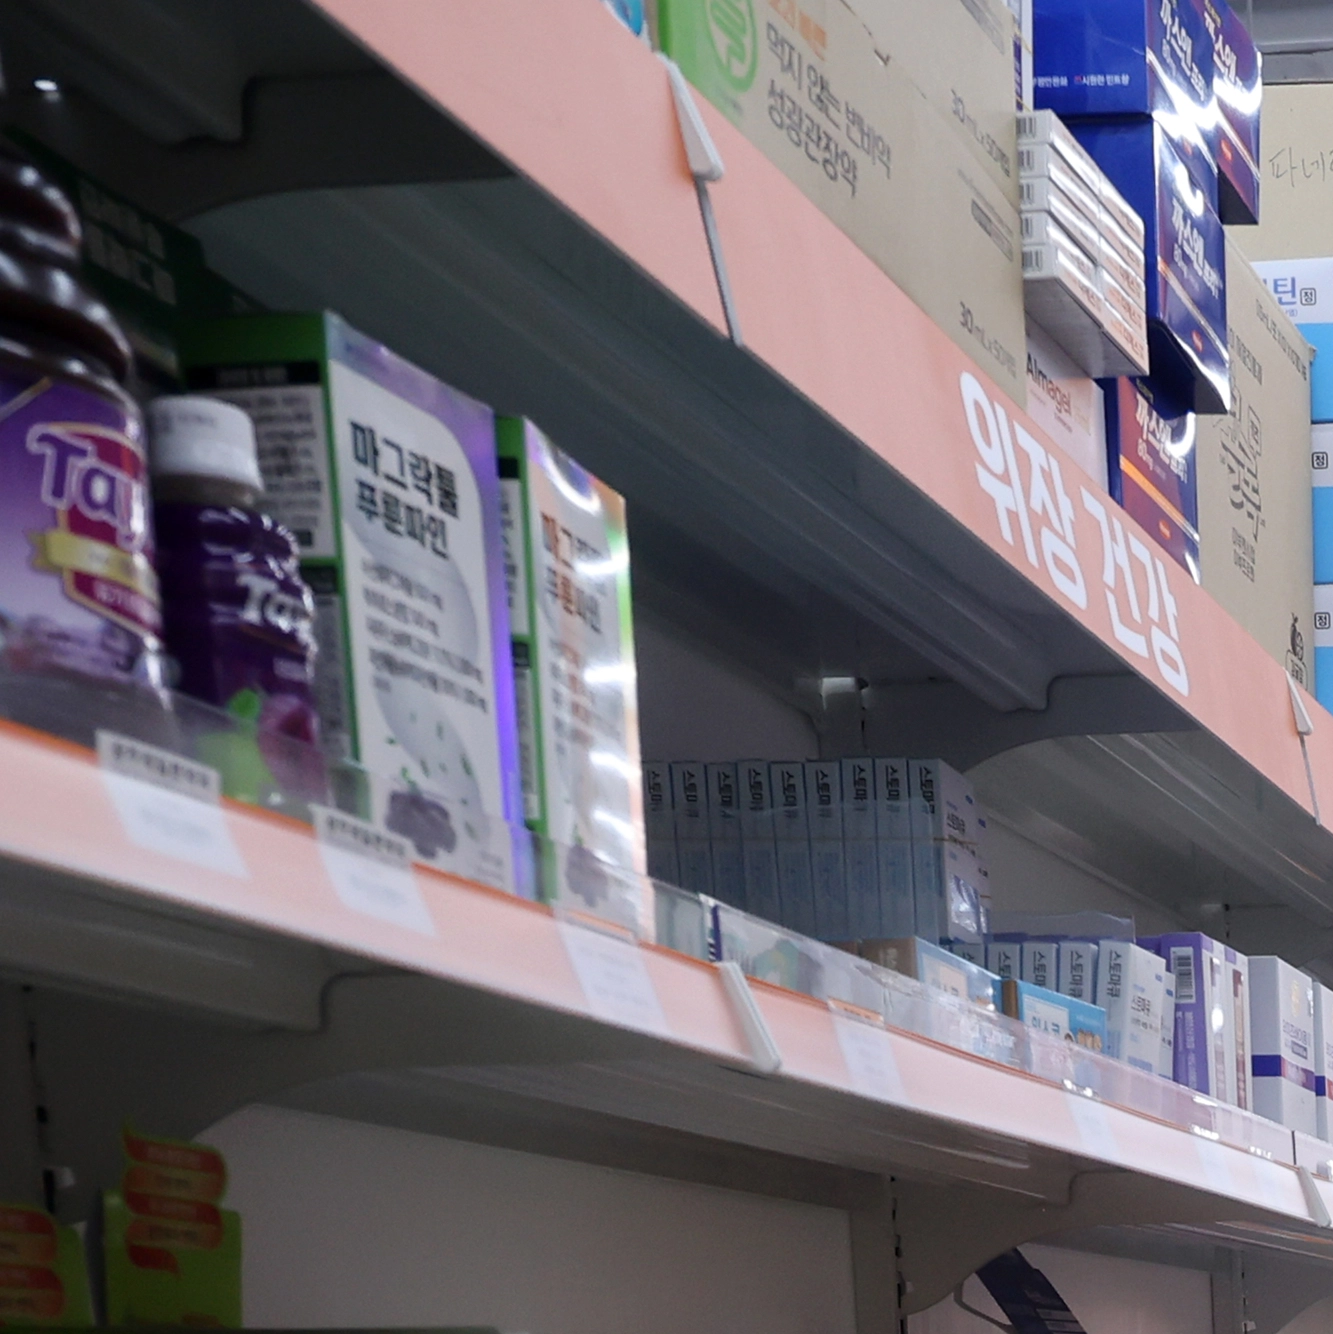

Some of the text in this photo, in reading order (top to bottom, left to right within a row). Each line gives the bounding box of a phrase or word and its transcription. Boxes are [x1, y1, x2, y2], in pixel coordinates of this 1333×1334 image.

[766, 22, 892, 181] 먹지 않는 변비약
[1026, 352, 1072, 416] Almagel
[958, 369, 1088, 611] 위장
[1078, 482, 1190, 699] 건강
